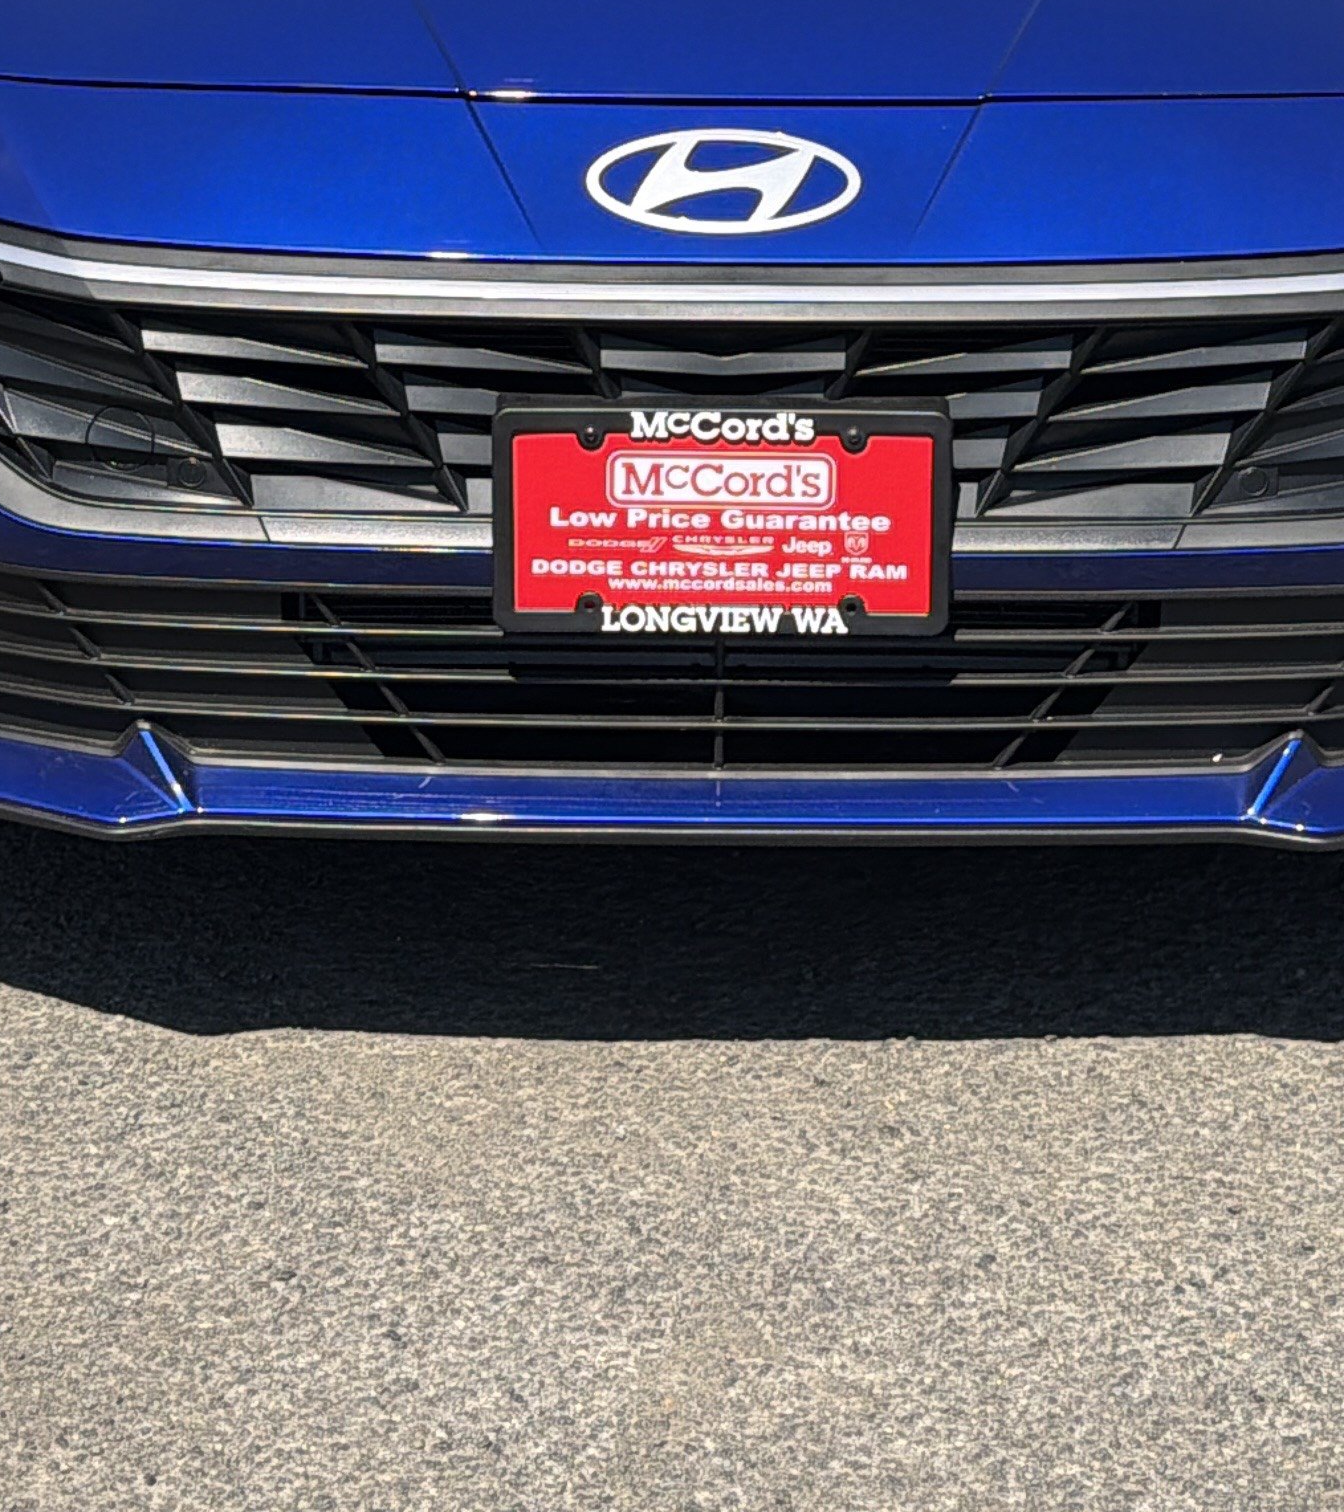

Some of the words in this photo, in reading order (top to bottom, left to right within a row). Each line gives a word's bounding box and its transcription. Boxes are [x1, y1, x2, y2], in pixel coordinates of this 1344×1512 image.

[630, 411, 815, 442] McCord's
[621, 462, 821, 498] McCord's
[549, 506, 617, 527] Low
[626, 508, 711, 529] Price
[720, 509, 892, 532] Guarantee
[671, 535, 774, 544] CHRYSLER
[781, 536, 833, 557] Jeep
[531, 559, 624, 575] DODGE
[630, 560, 769, 578] CHRYSLER
[775, 562, 842, 579] JEEP
[849, 564, 908, 580] RAM
[608, 577, 833, 593] www.mccordsales.com
[601, 605, 783, 633] LONGVIEW
[791, 606, 849, 634] WA
